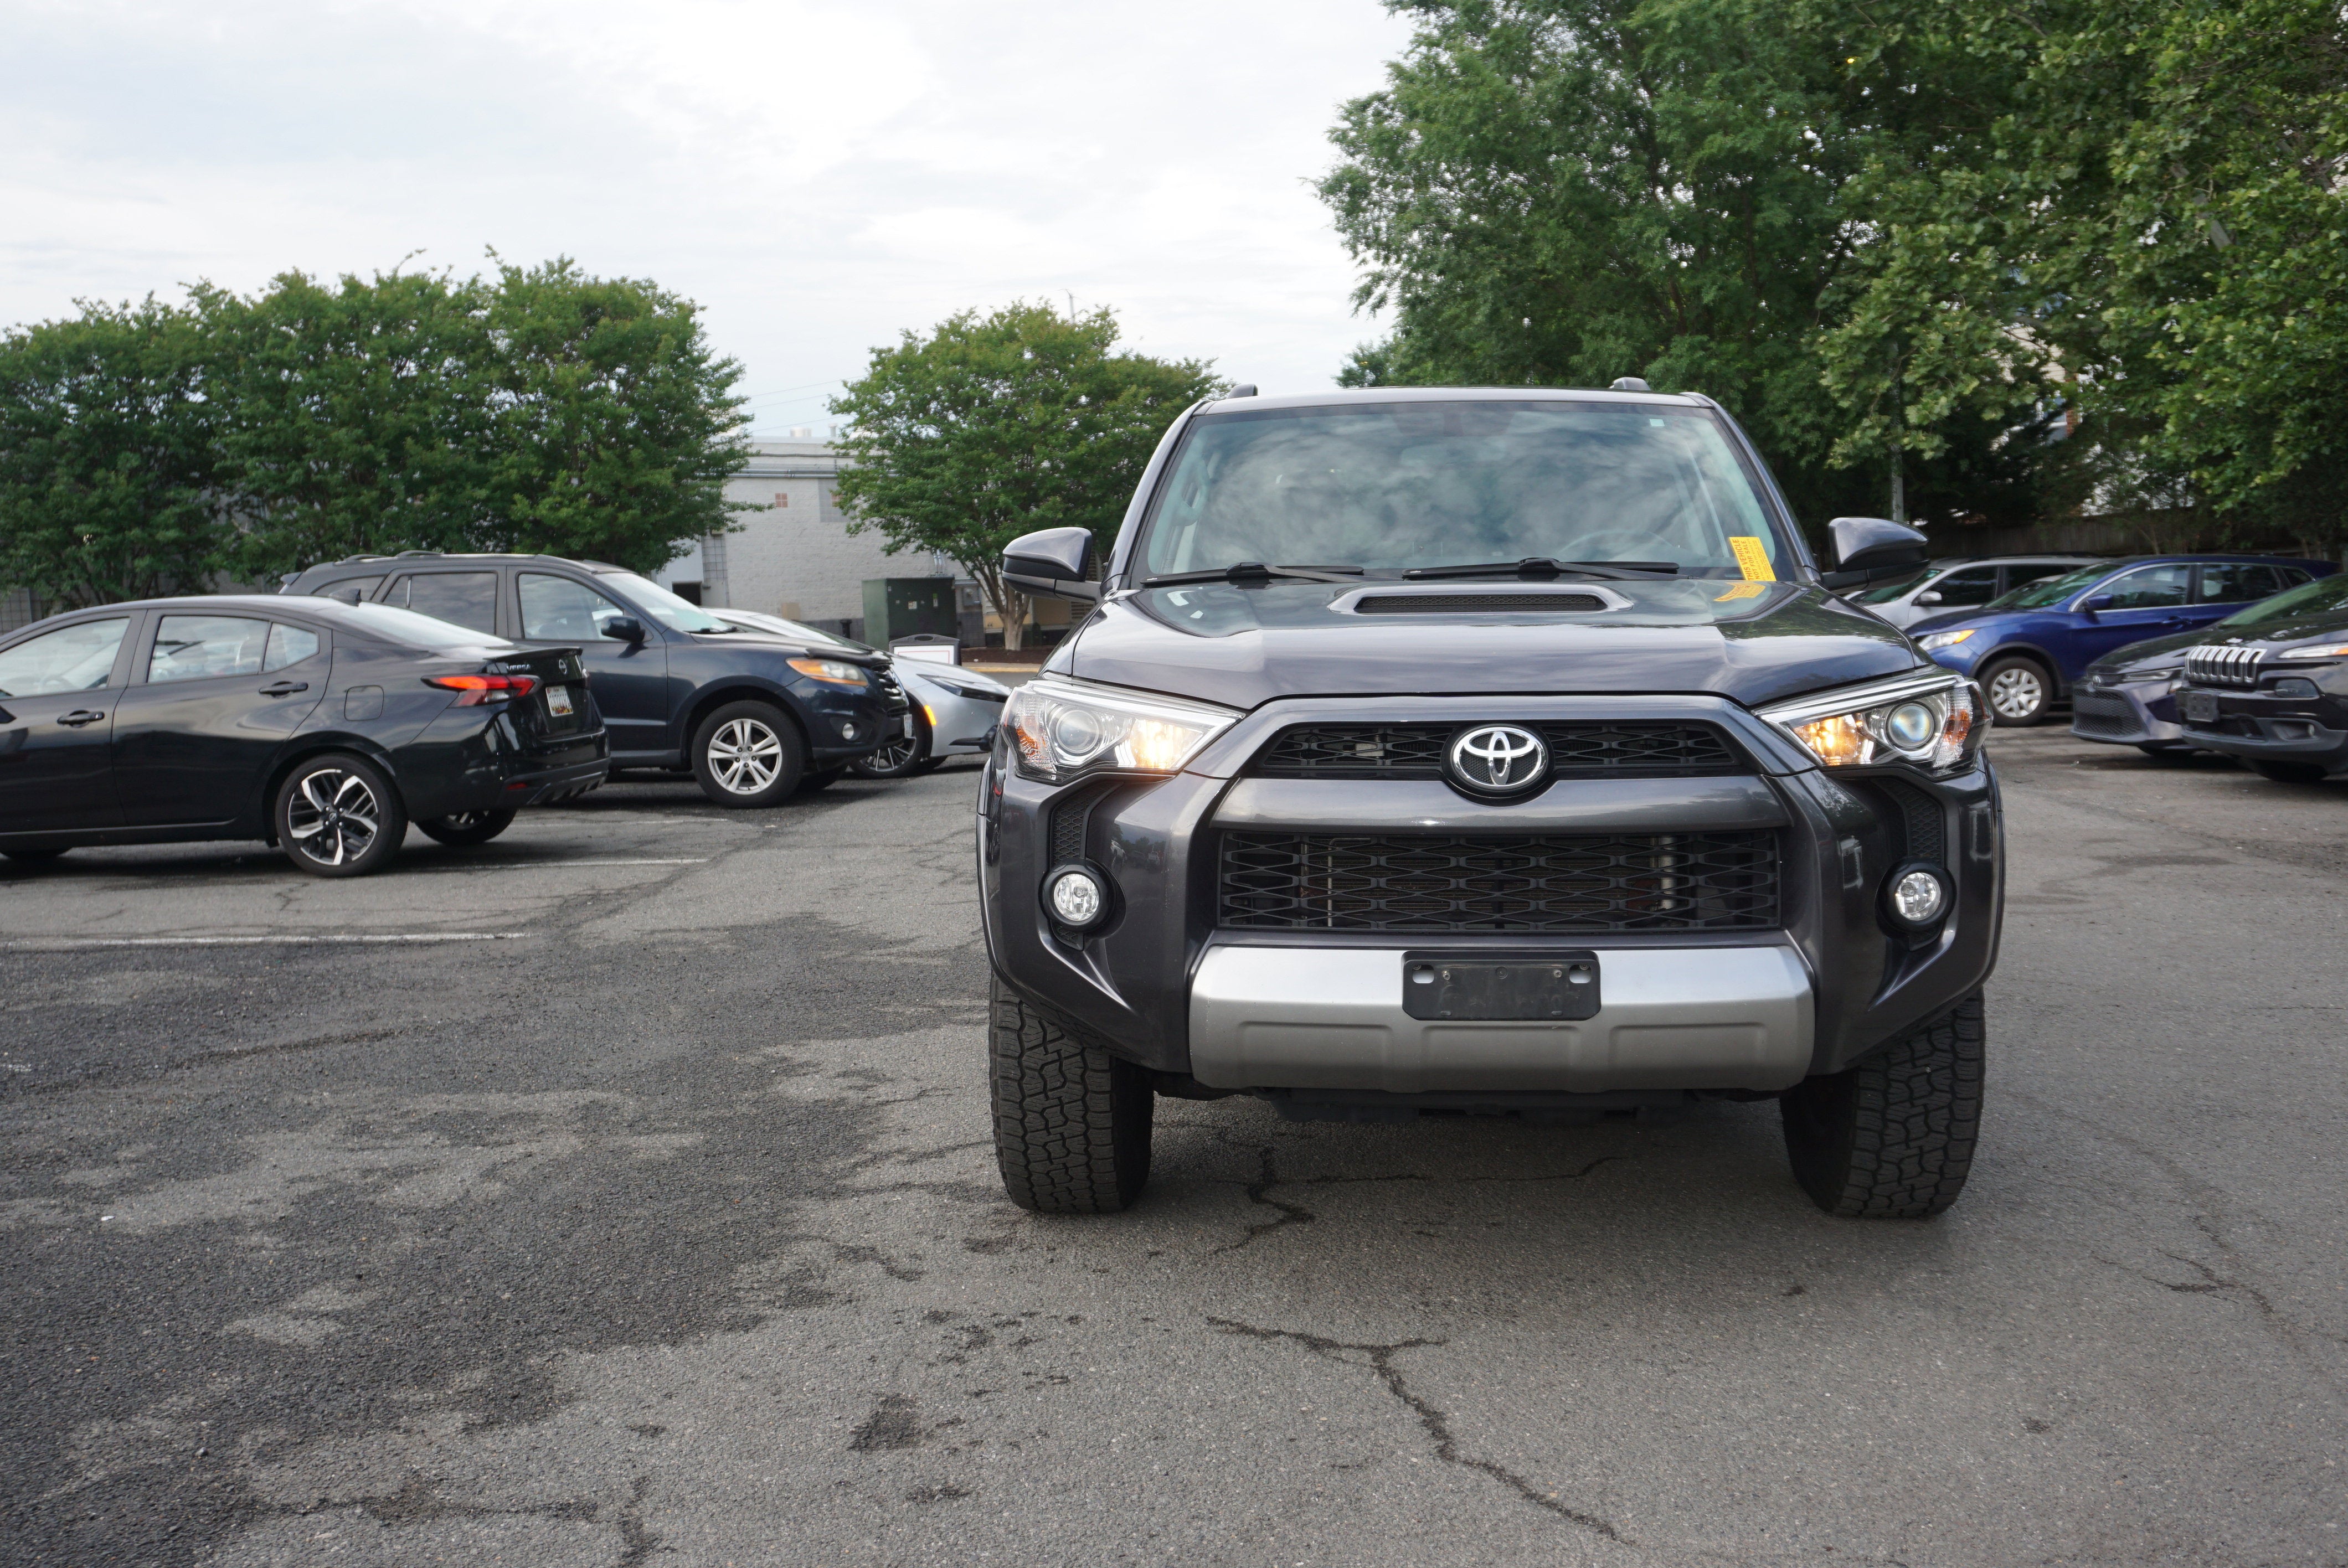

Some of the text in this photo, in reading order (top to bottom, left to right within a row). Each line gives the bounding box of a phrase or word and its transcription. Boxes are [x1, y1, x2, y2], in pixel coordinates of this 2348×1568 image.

[1732, 539, 1754, 580] THIS VEHICLE
[1741, 540, 1750, 554] SALE
